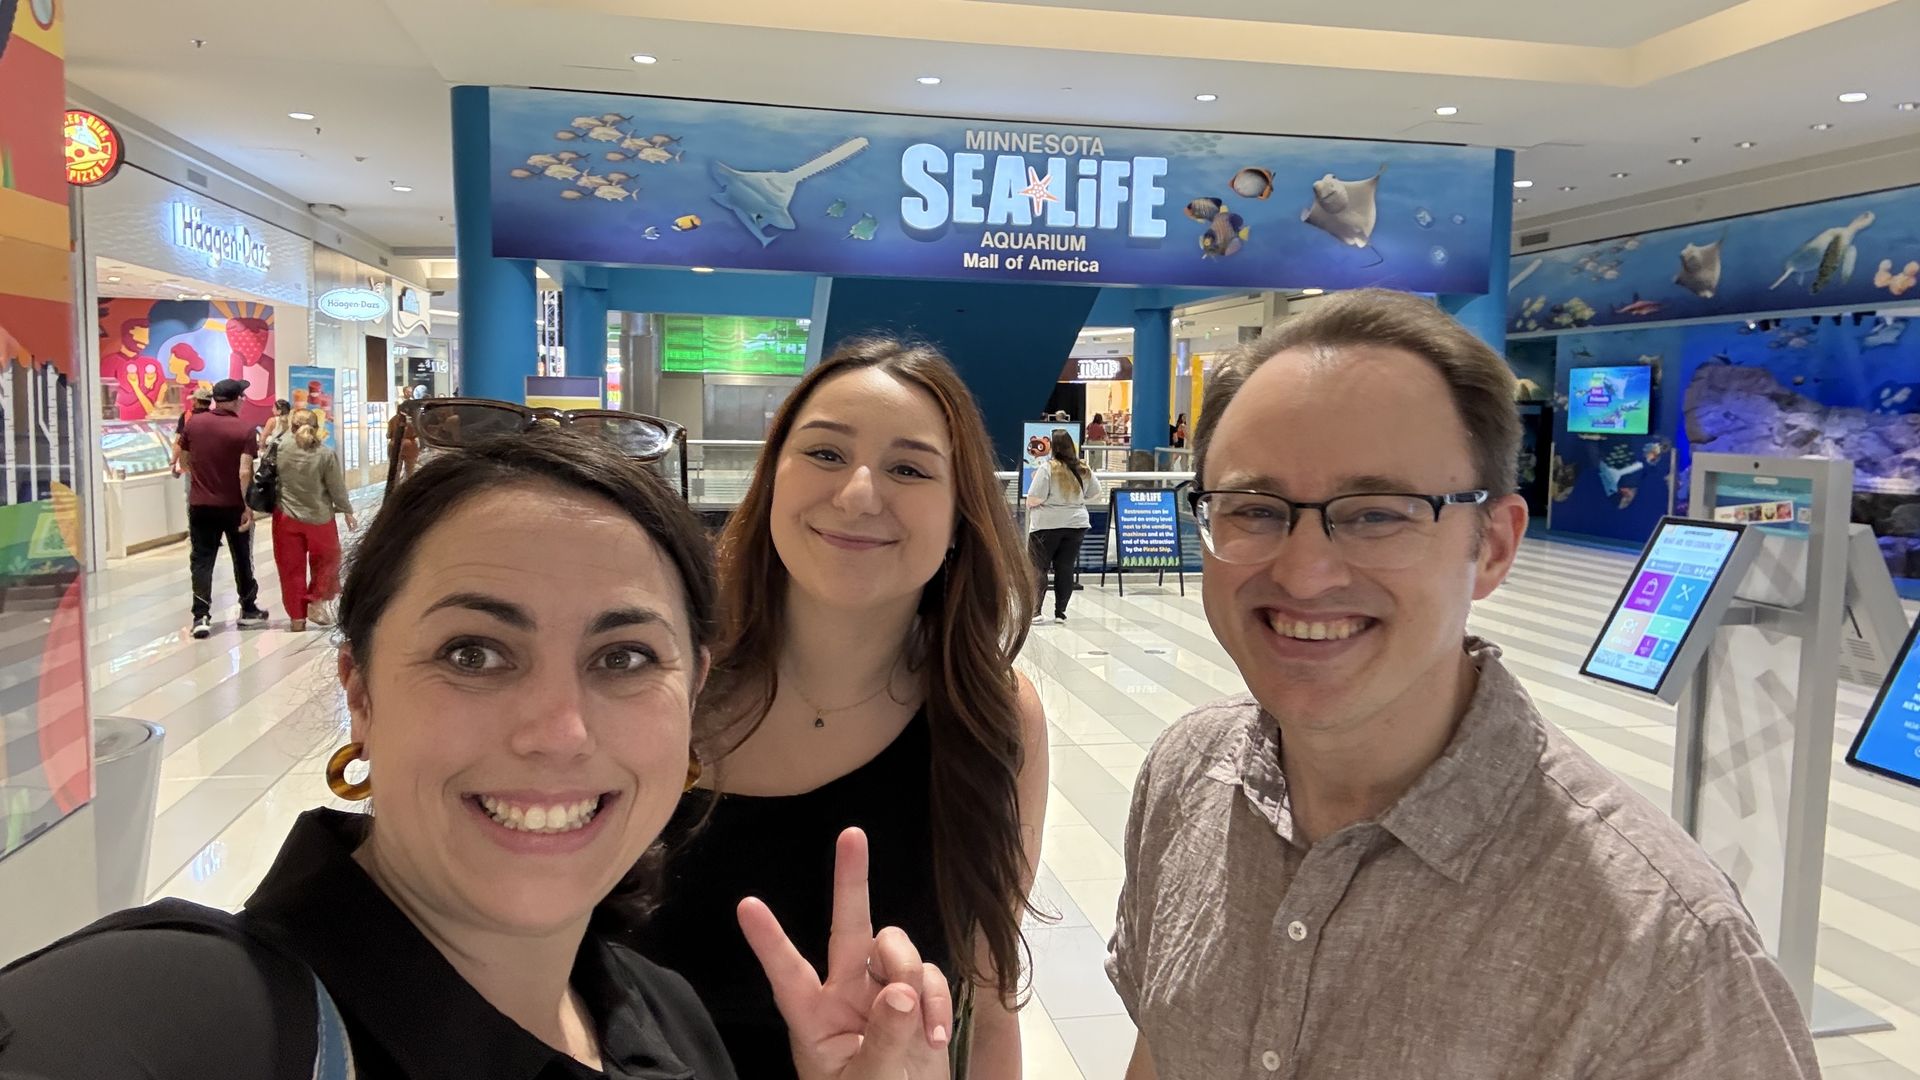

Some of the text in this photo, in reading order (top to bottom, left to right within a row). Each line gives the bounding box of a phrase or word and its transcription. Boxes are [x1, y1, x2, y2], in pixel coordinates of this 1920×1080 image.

[966, 130, 1105, 156] MINNESOTA
[901, 143, 1033, 230] SEA
[980, 231, 1086, 251] AQUARIUM
[963, 252, 1099, 273] Mall of America
